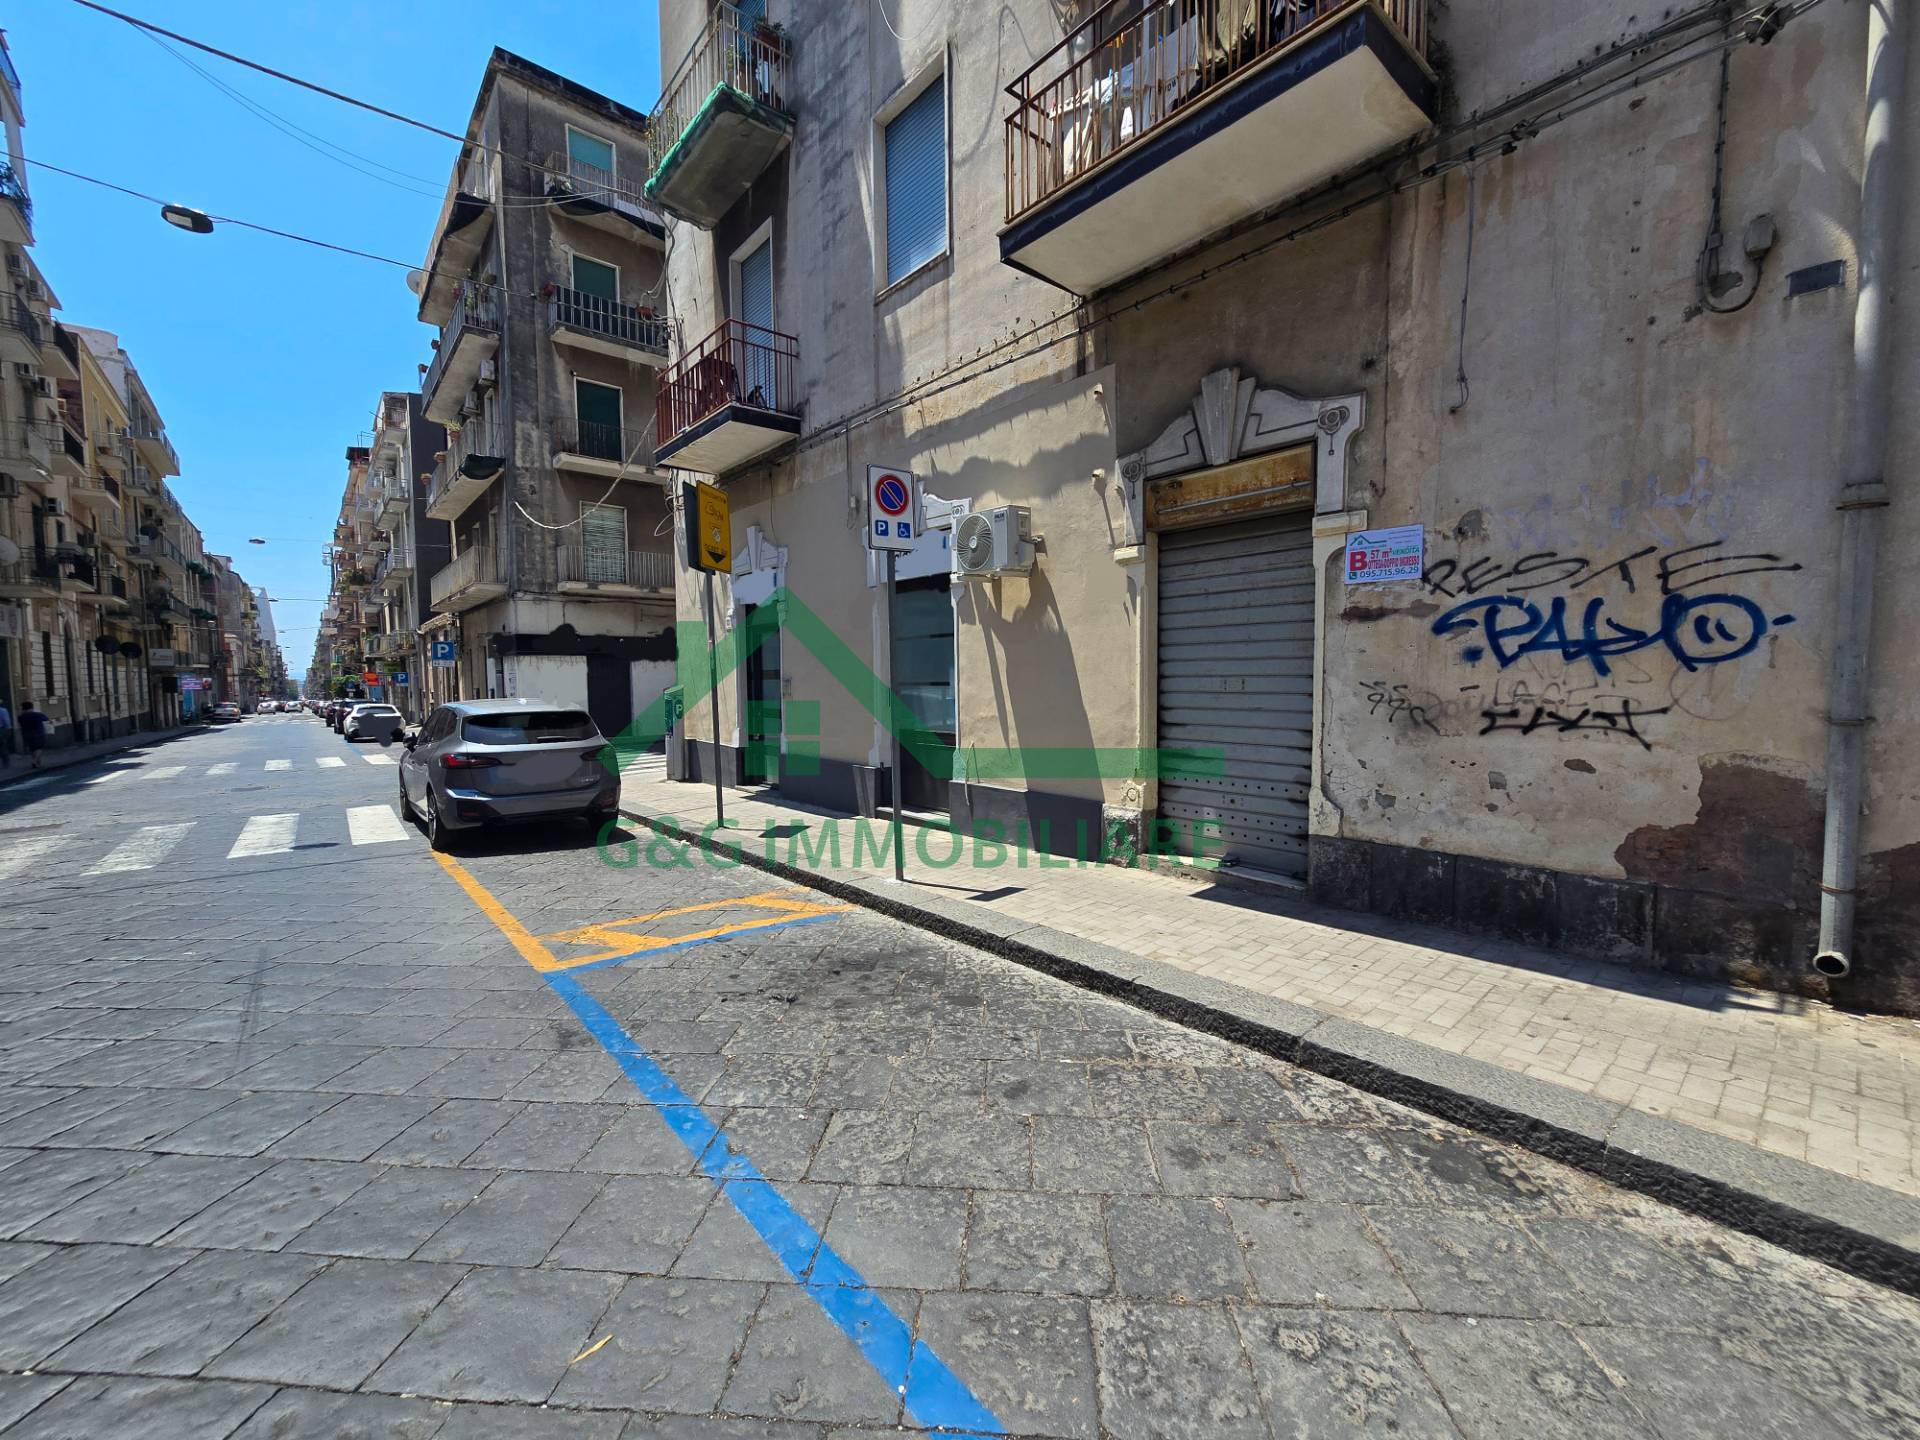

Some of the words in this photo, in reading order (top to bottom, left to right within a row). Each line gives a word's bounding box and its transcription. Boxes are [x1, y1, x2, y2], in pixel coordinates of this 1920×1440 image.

[878, 523, 885, 534] P
[1371, 549, 1379, 560] 57
[1360, 566, 1419, 578] 095.715.96.29
[437, 644, 449, 657] P
[676, 704, 683, 715] P
